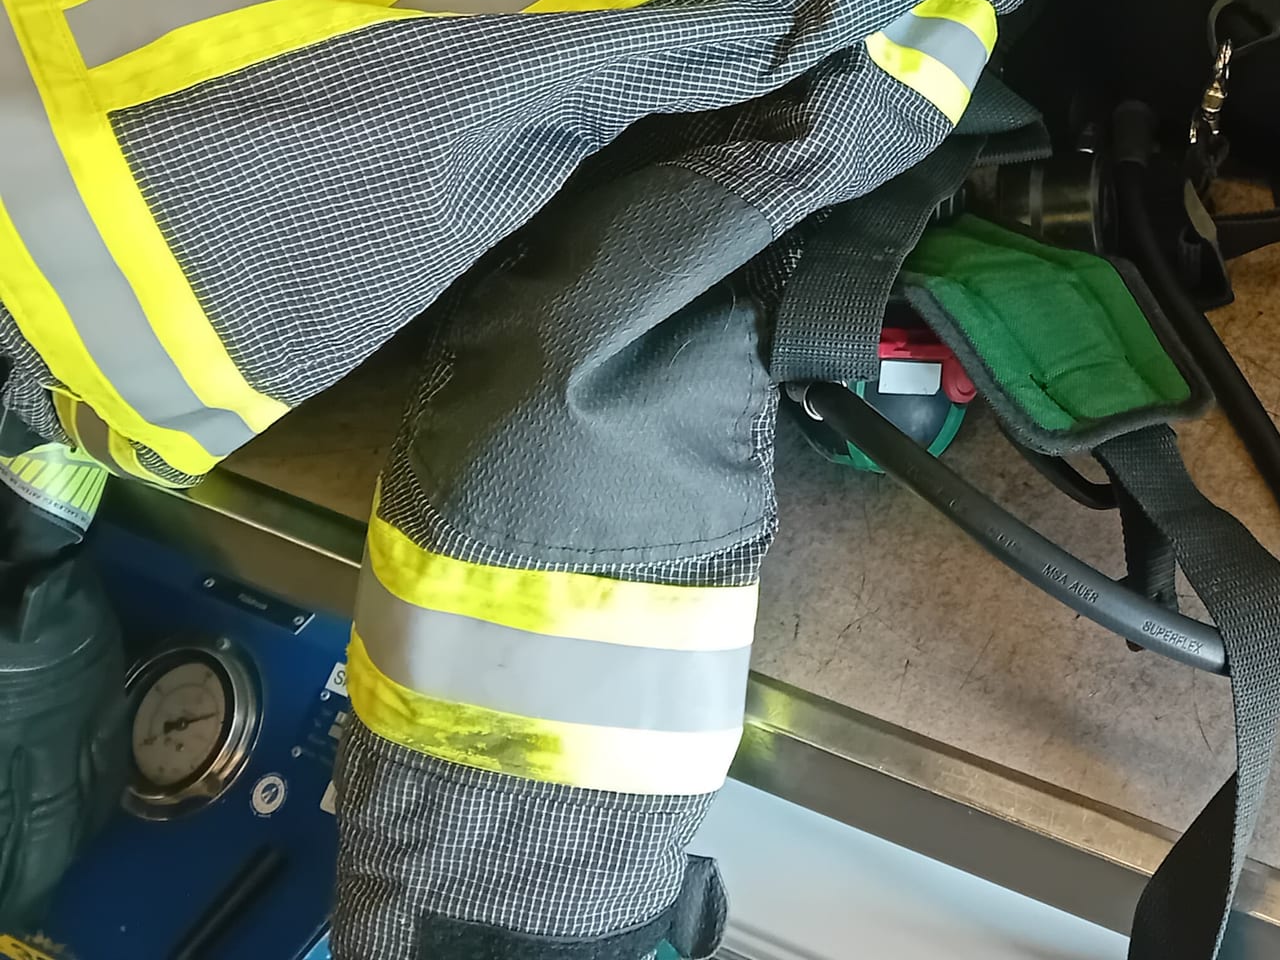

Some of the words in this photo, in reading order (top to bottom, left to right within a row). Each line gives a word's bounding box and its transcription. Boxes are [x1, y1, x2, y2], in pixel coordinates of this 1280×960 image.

[1042, 563, 1069, 585] MSA
[1068, 580, 1099, 603] AUER
[1141, 620, 1204, 655] SUPERFLEX
